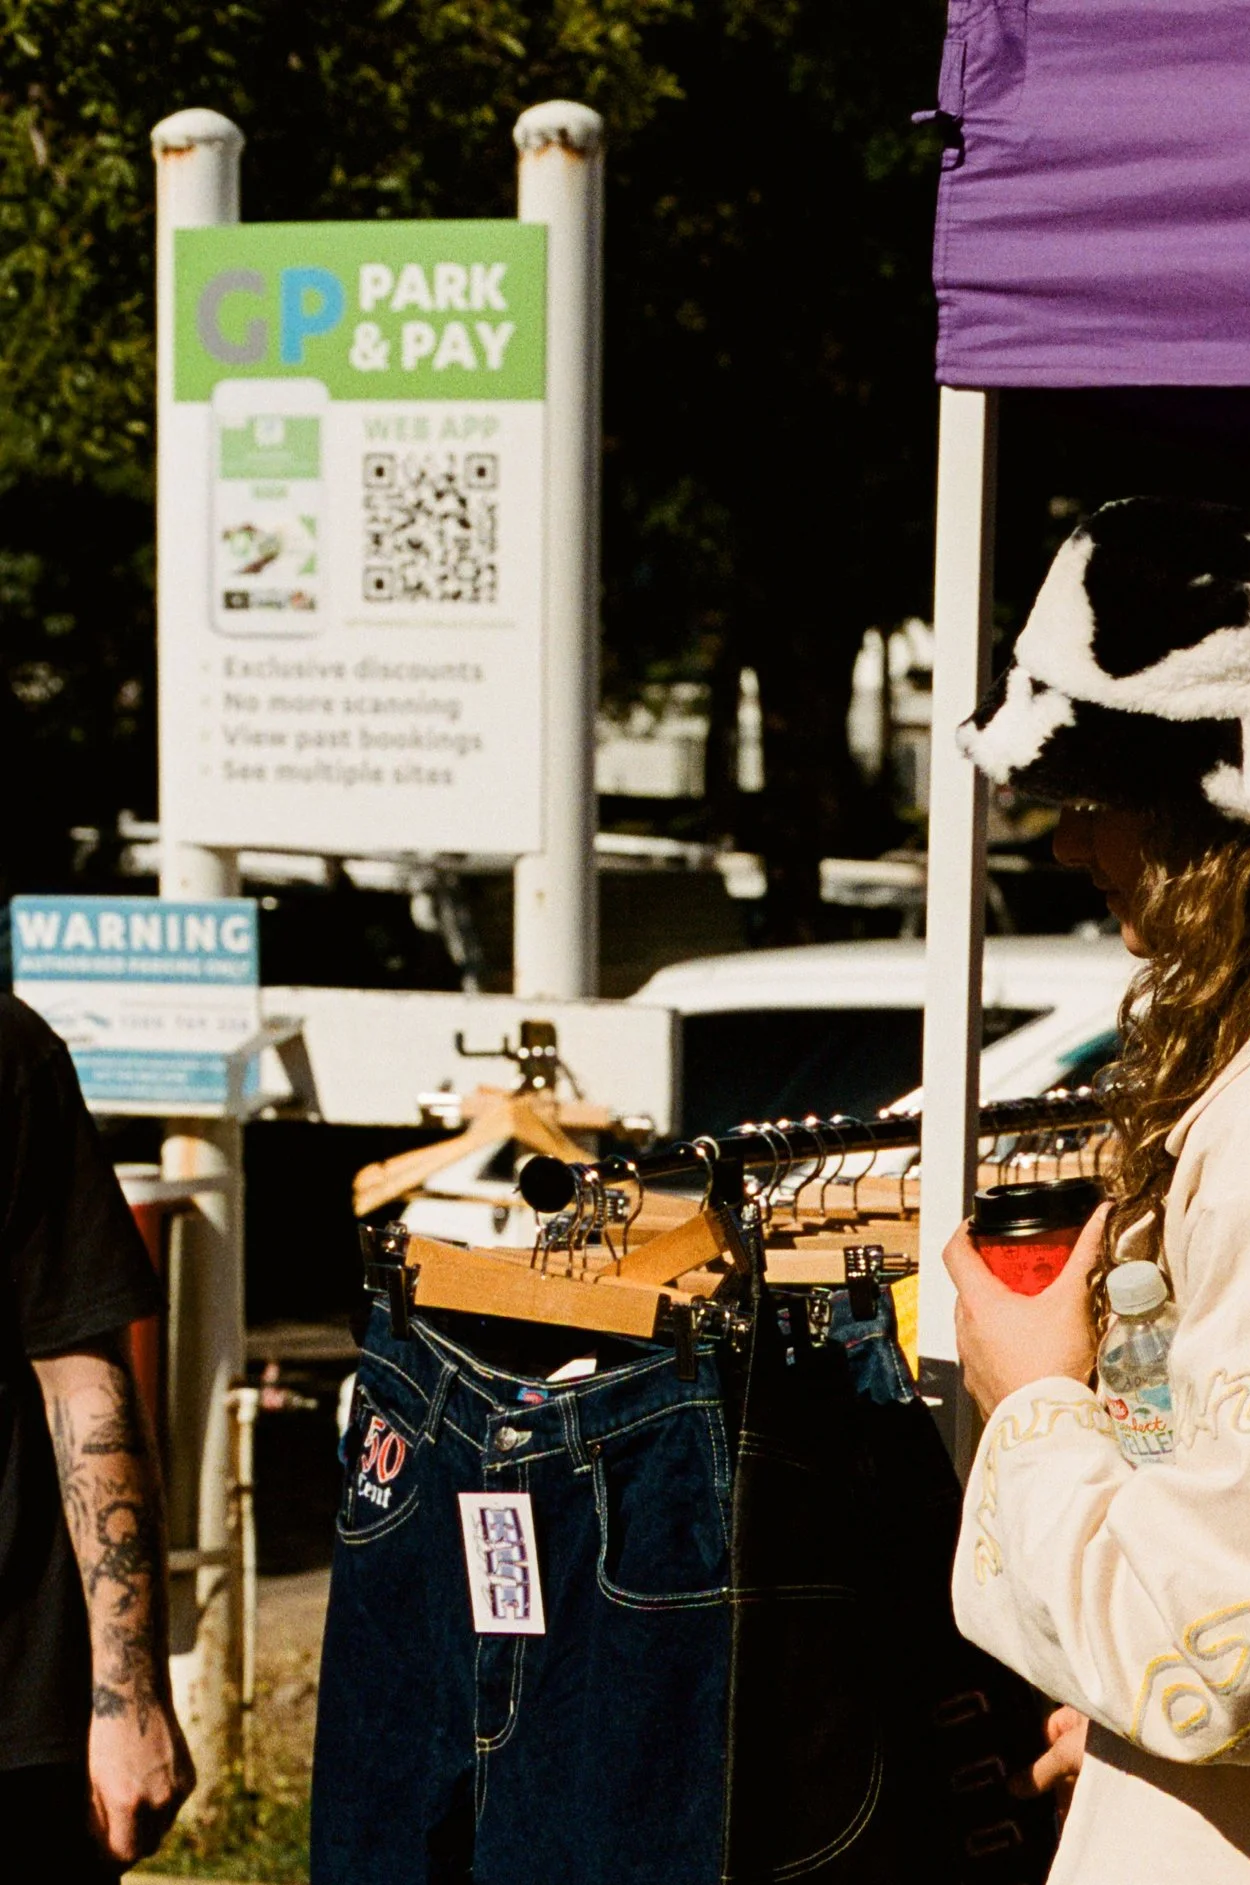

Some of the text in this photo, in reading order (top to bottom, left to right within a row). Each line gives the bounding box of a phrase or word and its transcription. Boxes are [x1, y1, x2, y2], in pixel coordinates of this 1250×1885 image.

[359, 262, 508, 312] PARK
[196, 266, 346, 367] GP
[348, 321, 516, 371] & PAY
[438, 413, 500, 440] APP
[223, 654, 485, 683] Exclusive discounts
[223, 691, 260, 713] No
[268, 695, 334, 715] more
[222, 725, 484, 756] View past bookings
[223, 758, 455, 788] See multiple sites
[15, 910, 251, 954] WARNING
[361, 1415, 406, 1484] 50
